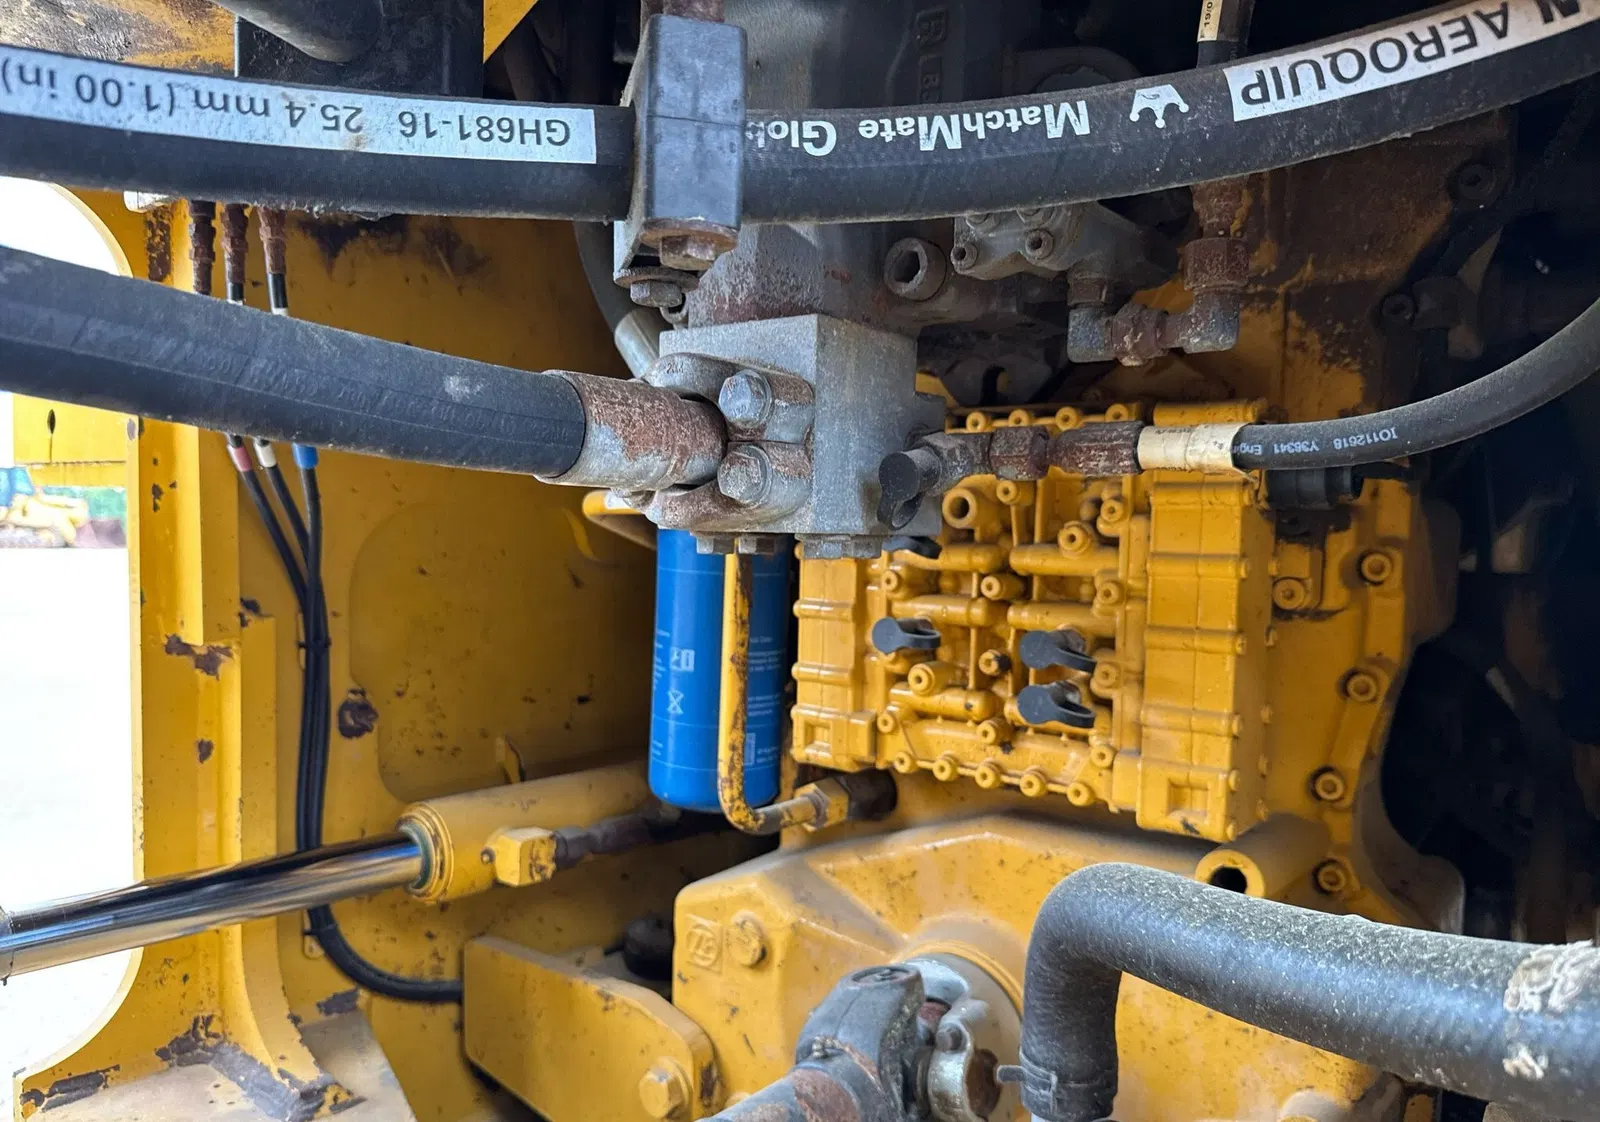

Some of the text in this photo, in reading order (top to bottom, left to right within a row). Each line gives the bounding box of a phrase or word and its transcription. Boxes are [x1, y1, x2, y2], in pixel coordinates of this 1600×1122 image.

[1241, 2, 1510, 105] AEROQUIP
[1, 57, 571, 146] GH681-16 25.4 mm (1.00 in)
[859, 100, 1090, 152] MatchMate
